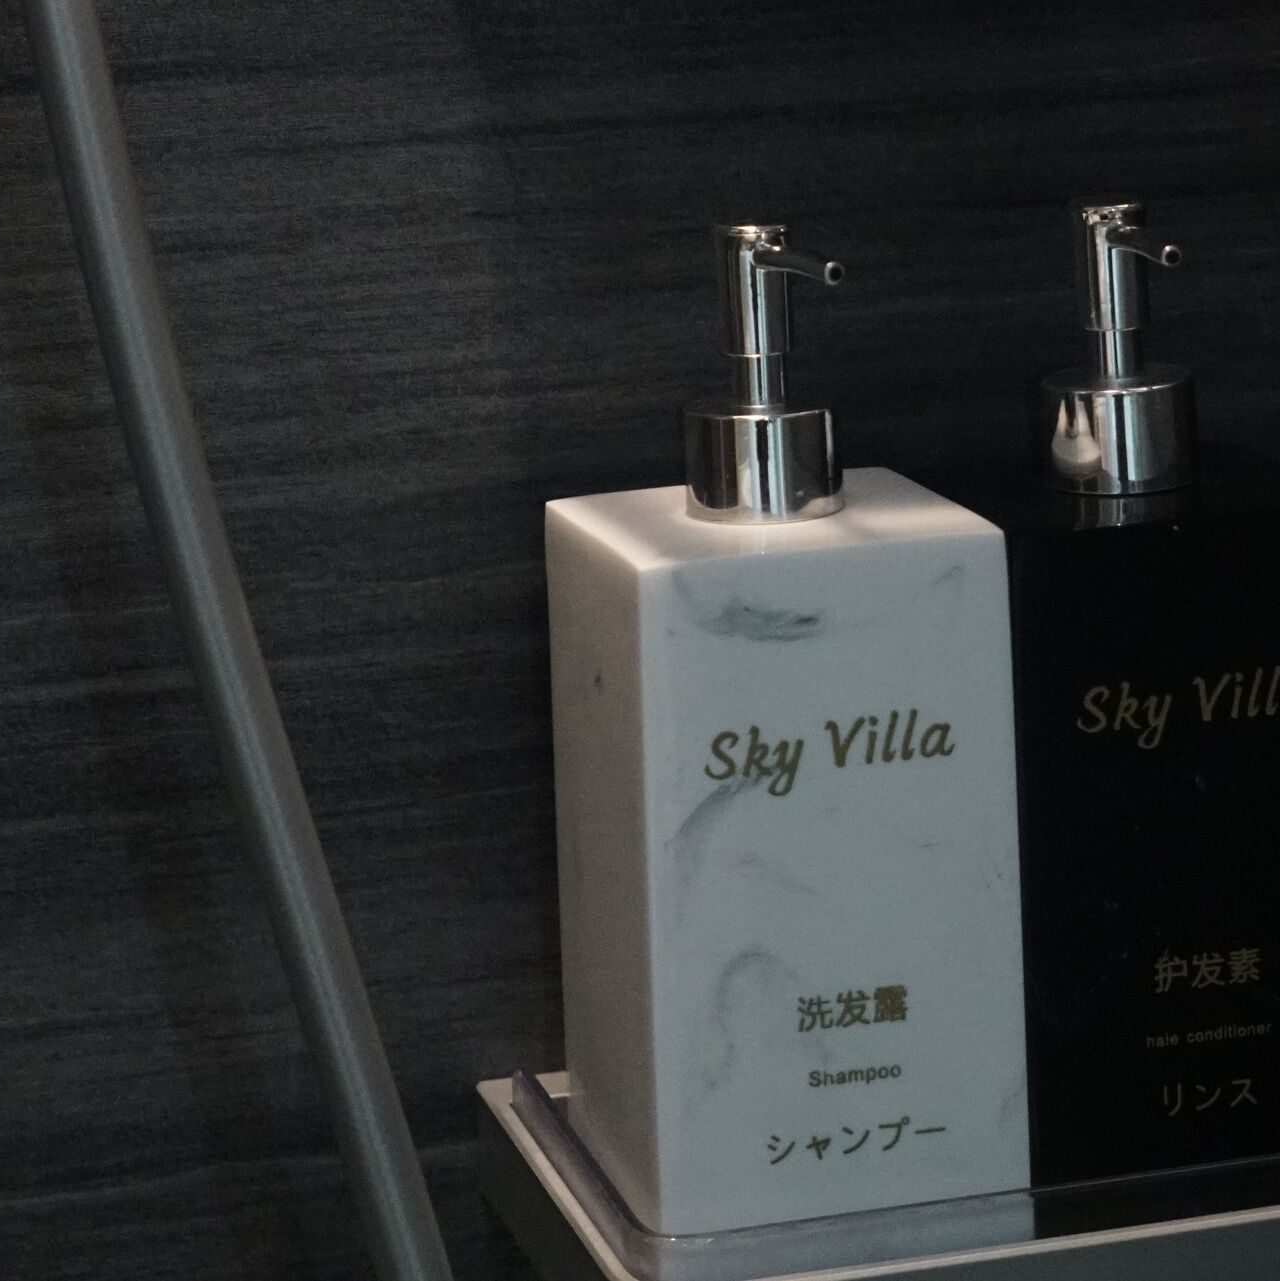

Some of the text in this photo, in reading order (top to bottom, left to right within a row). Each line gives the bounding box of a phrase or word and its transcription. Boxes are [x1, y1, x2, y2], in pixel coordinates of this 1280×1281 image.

[1077, 680, 1173, 749] Sky
[704, 708, 955, 797] Sky Villa
[1153, 946, 1262, 994] 护发素
[797, 984, 908, 1033] 洗发露
[1186, 1022, 1272, 1044] conditioner
[808, 1064, 902, 1088] Shampoo
[1162, 1078, 1258, 1118] リンス
[767, 1116, 947, 1165] シャンプー
